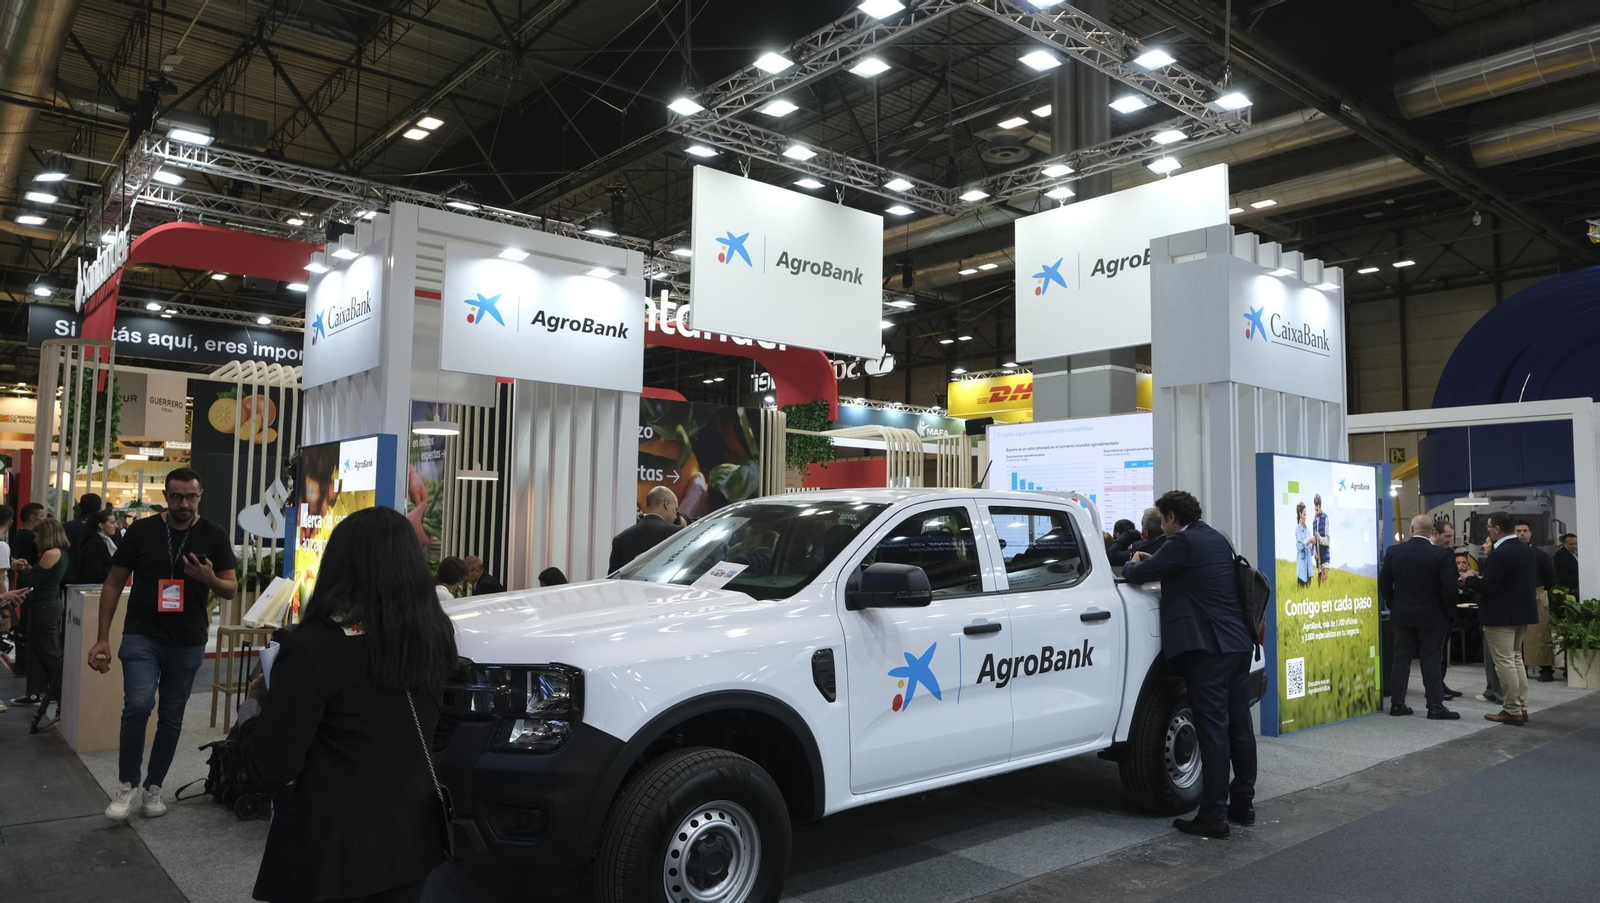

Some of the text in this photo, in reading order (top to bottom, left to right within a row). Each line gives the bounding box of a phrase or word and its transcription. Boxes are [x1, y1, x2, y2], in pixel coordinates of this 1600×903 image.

[775, 251, 863, 285] AgroBank
[1091, 247, 1151, 278] AgroB
[328, 289, 371, 329] CaixaBank
[530, 309, 629, 340] AgroBank
[54, 319, 304, 361] Si tás aquí, eres impor
[1270, 312, 1330, 351] CaixaBank
[149, 395, 183, 409] GUERRERO
[988, 383, 1032, 403] DH
[354, 459, 373, 471] AgroBank
[1351, 482, 1370, 491] AgroBank
[1285, 594, 1372, 619] Contigo en cada paso
[976, 639, 1094, 688] AgroBank
